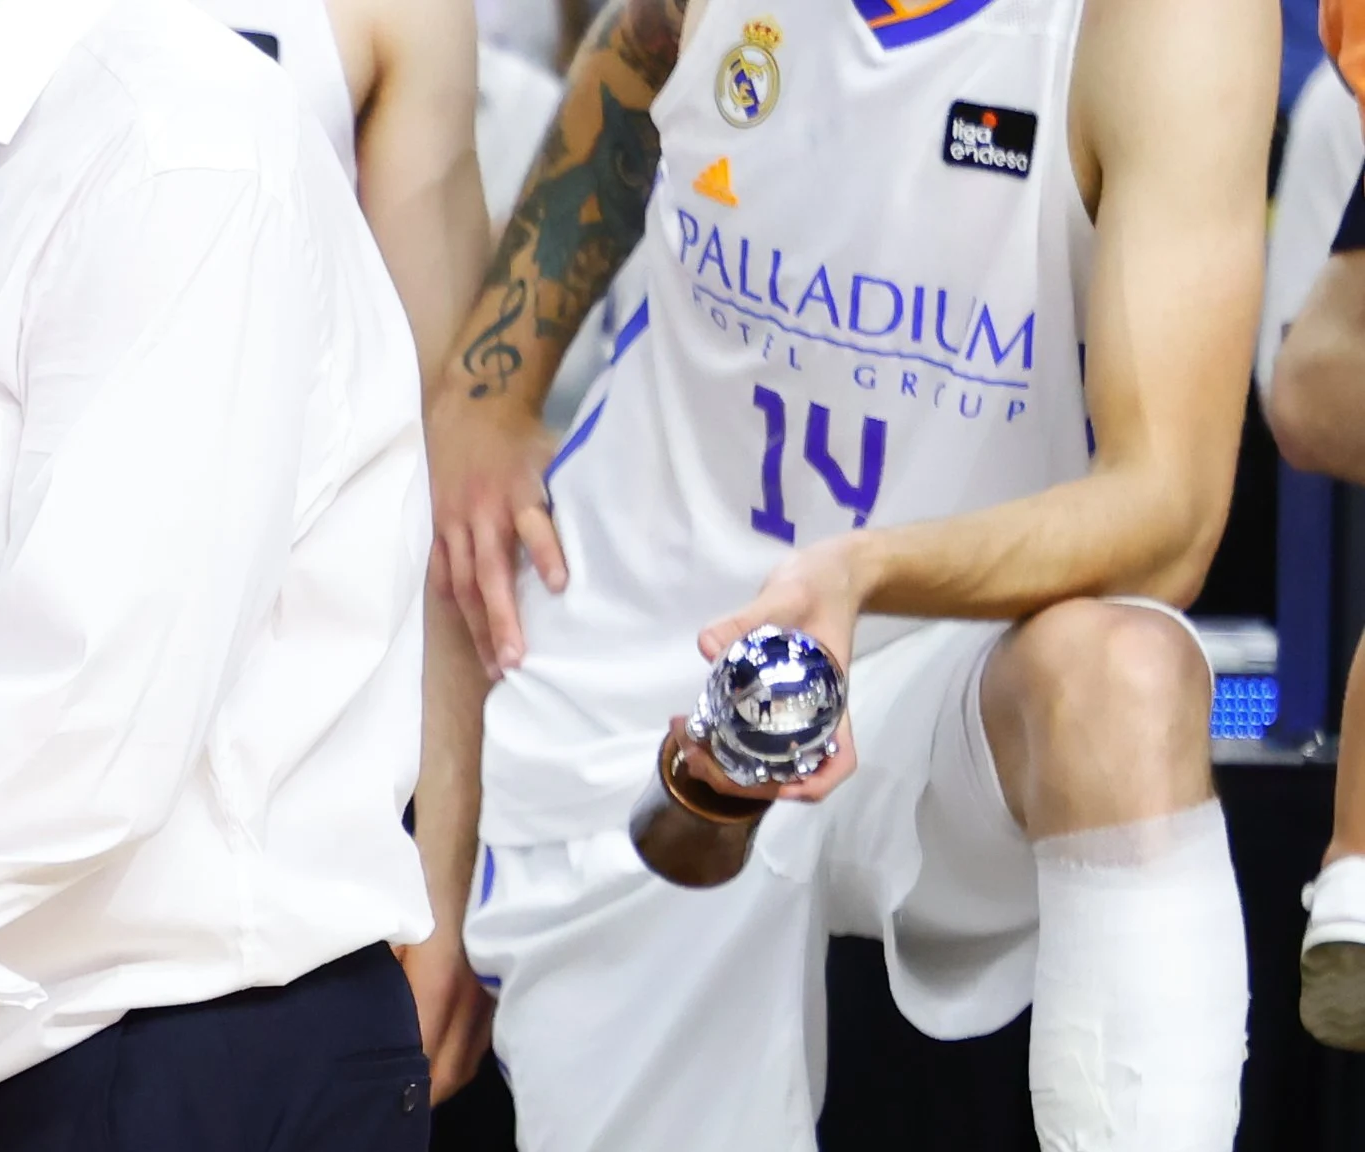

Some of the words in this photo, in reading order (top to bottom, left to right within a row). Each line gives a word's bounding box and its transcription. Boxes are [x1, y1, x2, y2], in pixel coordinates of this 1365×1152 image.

[950, 142, 1028, 171] endesa
[952, 117, 992, 146] liga
[677, 209, 1037, 370] PALLADIUM
[750, 383, 888, 545] 14
